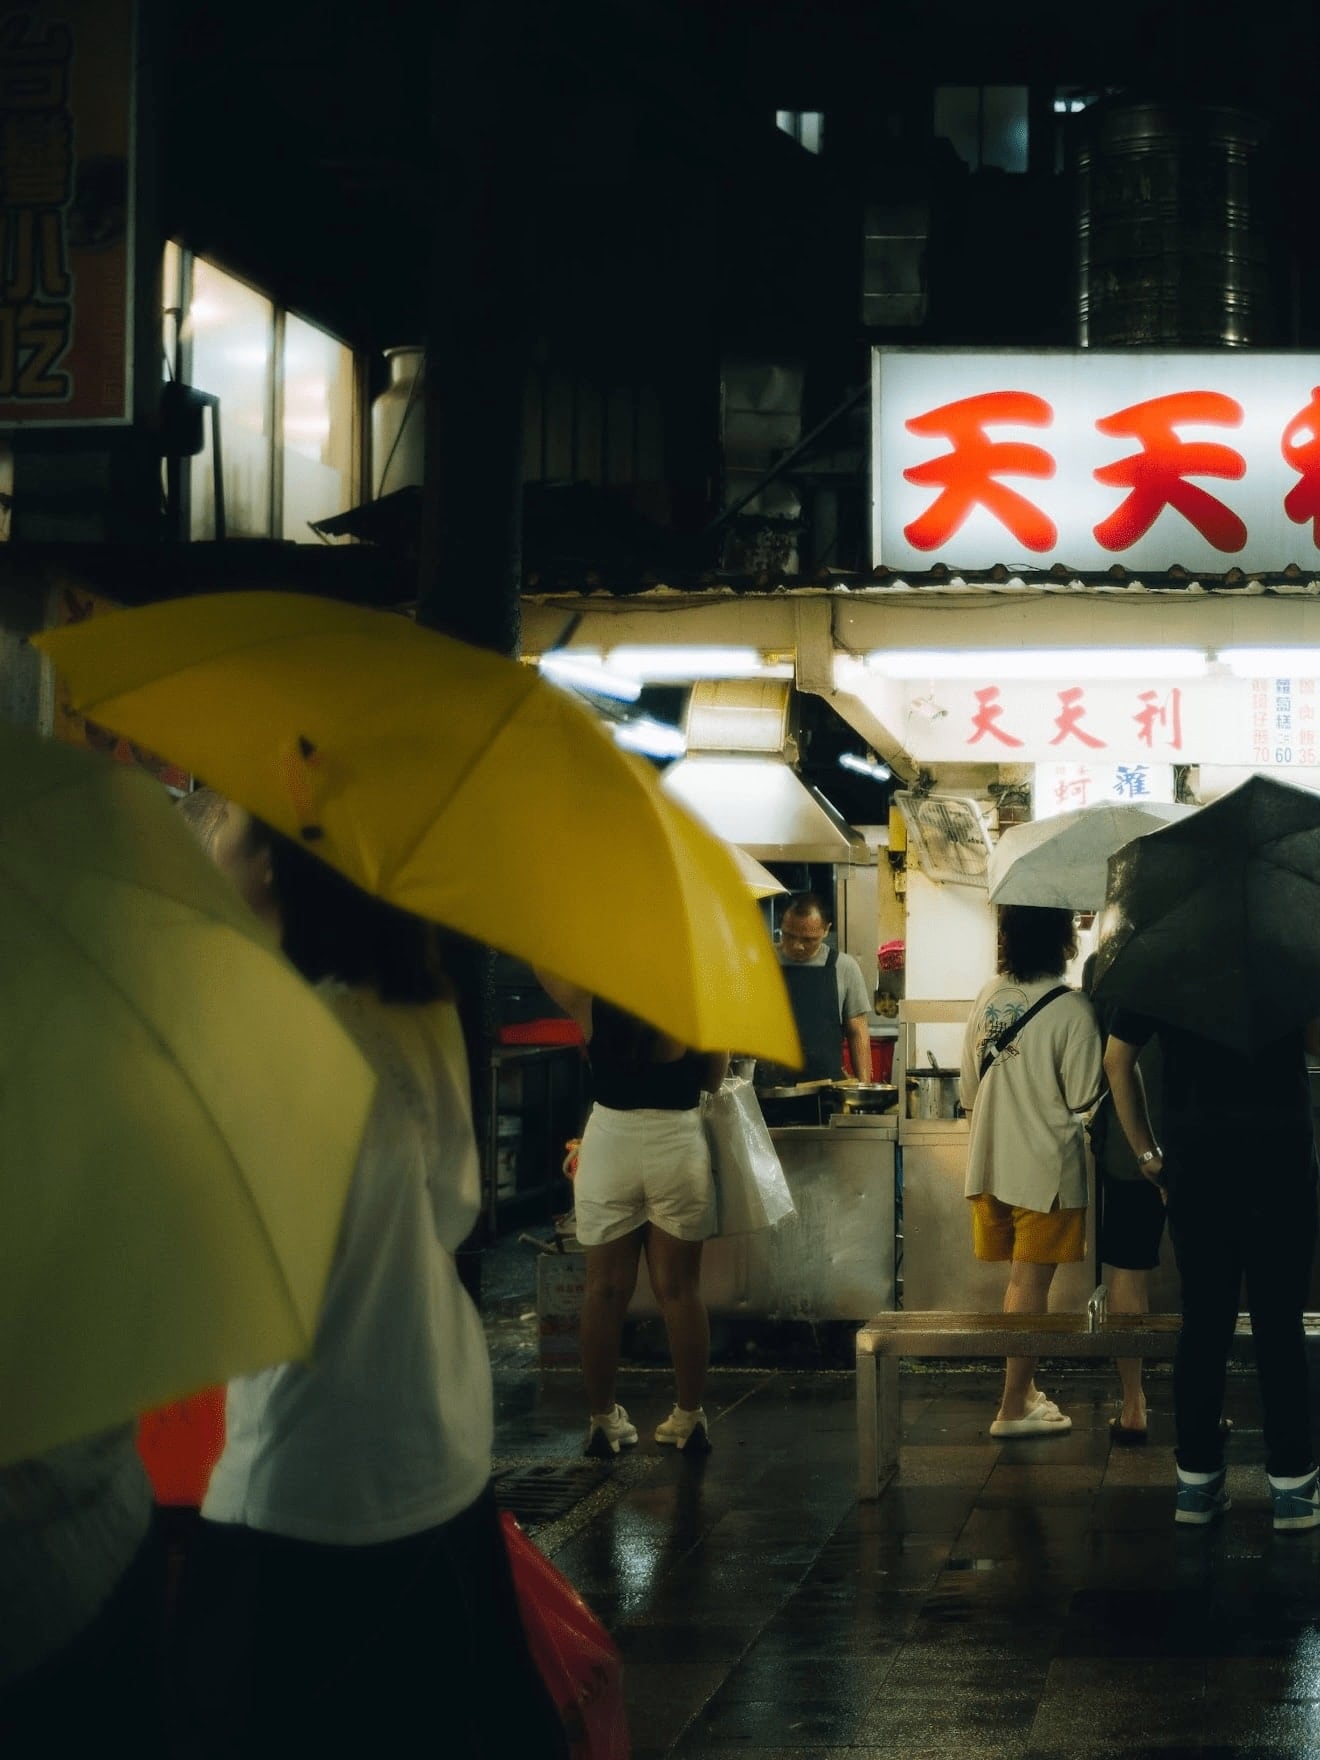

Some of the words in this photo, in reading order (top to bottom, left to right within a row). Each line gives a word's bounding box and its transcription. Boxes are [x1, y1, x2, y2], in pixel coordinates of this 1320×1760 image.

[966, 685, 1184, 751] 天天利
[1275, 747, 1292, 763] 60
